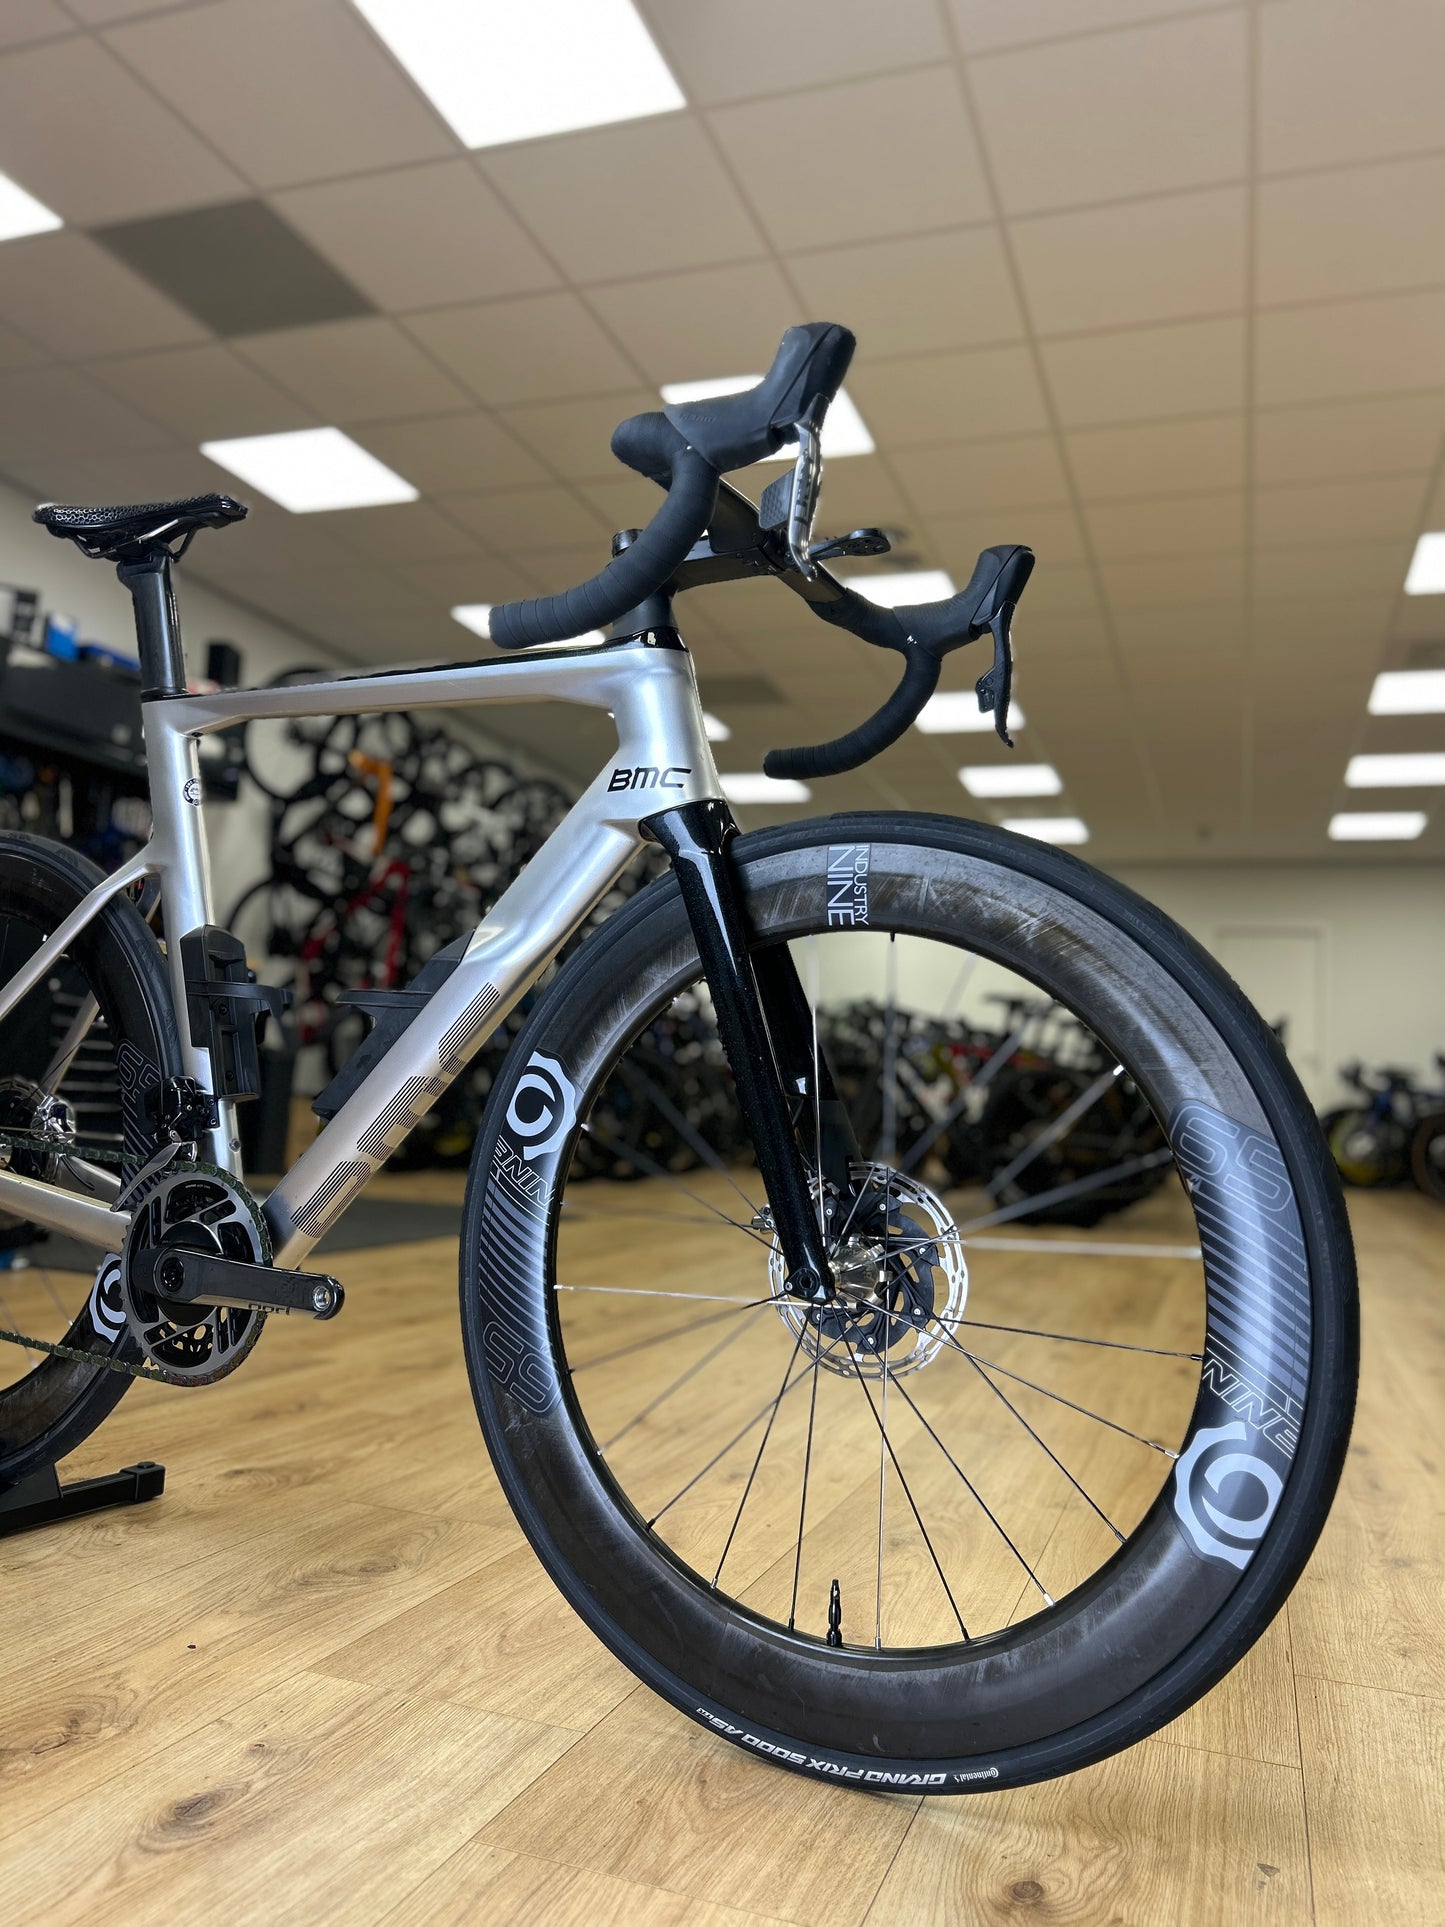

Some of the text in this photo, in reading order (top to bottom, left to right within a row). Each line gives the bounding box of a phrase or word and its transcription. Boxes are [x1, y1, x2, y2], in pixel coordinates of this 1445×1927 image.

[607, 766, 692, 793] BMC
[827, 846, 855, 925] NINE
[854, 845, 869, 925] INDUSTRY
[494, 1135, 555, 1206] NINE
[1170, 1105, 1292, 1212] 65
[483, 1321, 562, 1413] 65
[1202, 1359, 1300, 1460] NINE
[741, 1733, 808, 1765] 5000
[805, 1758, 864, 1779] PRIX
[863, 1771, 947, 1785] GRAND
[959, 1767, 999, 1783] Continental
